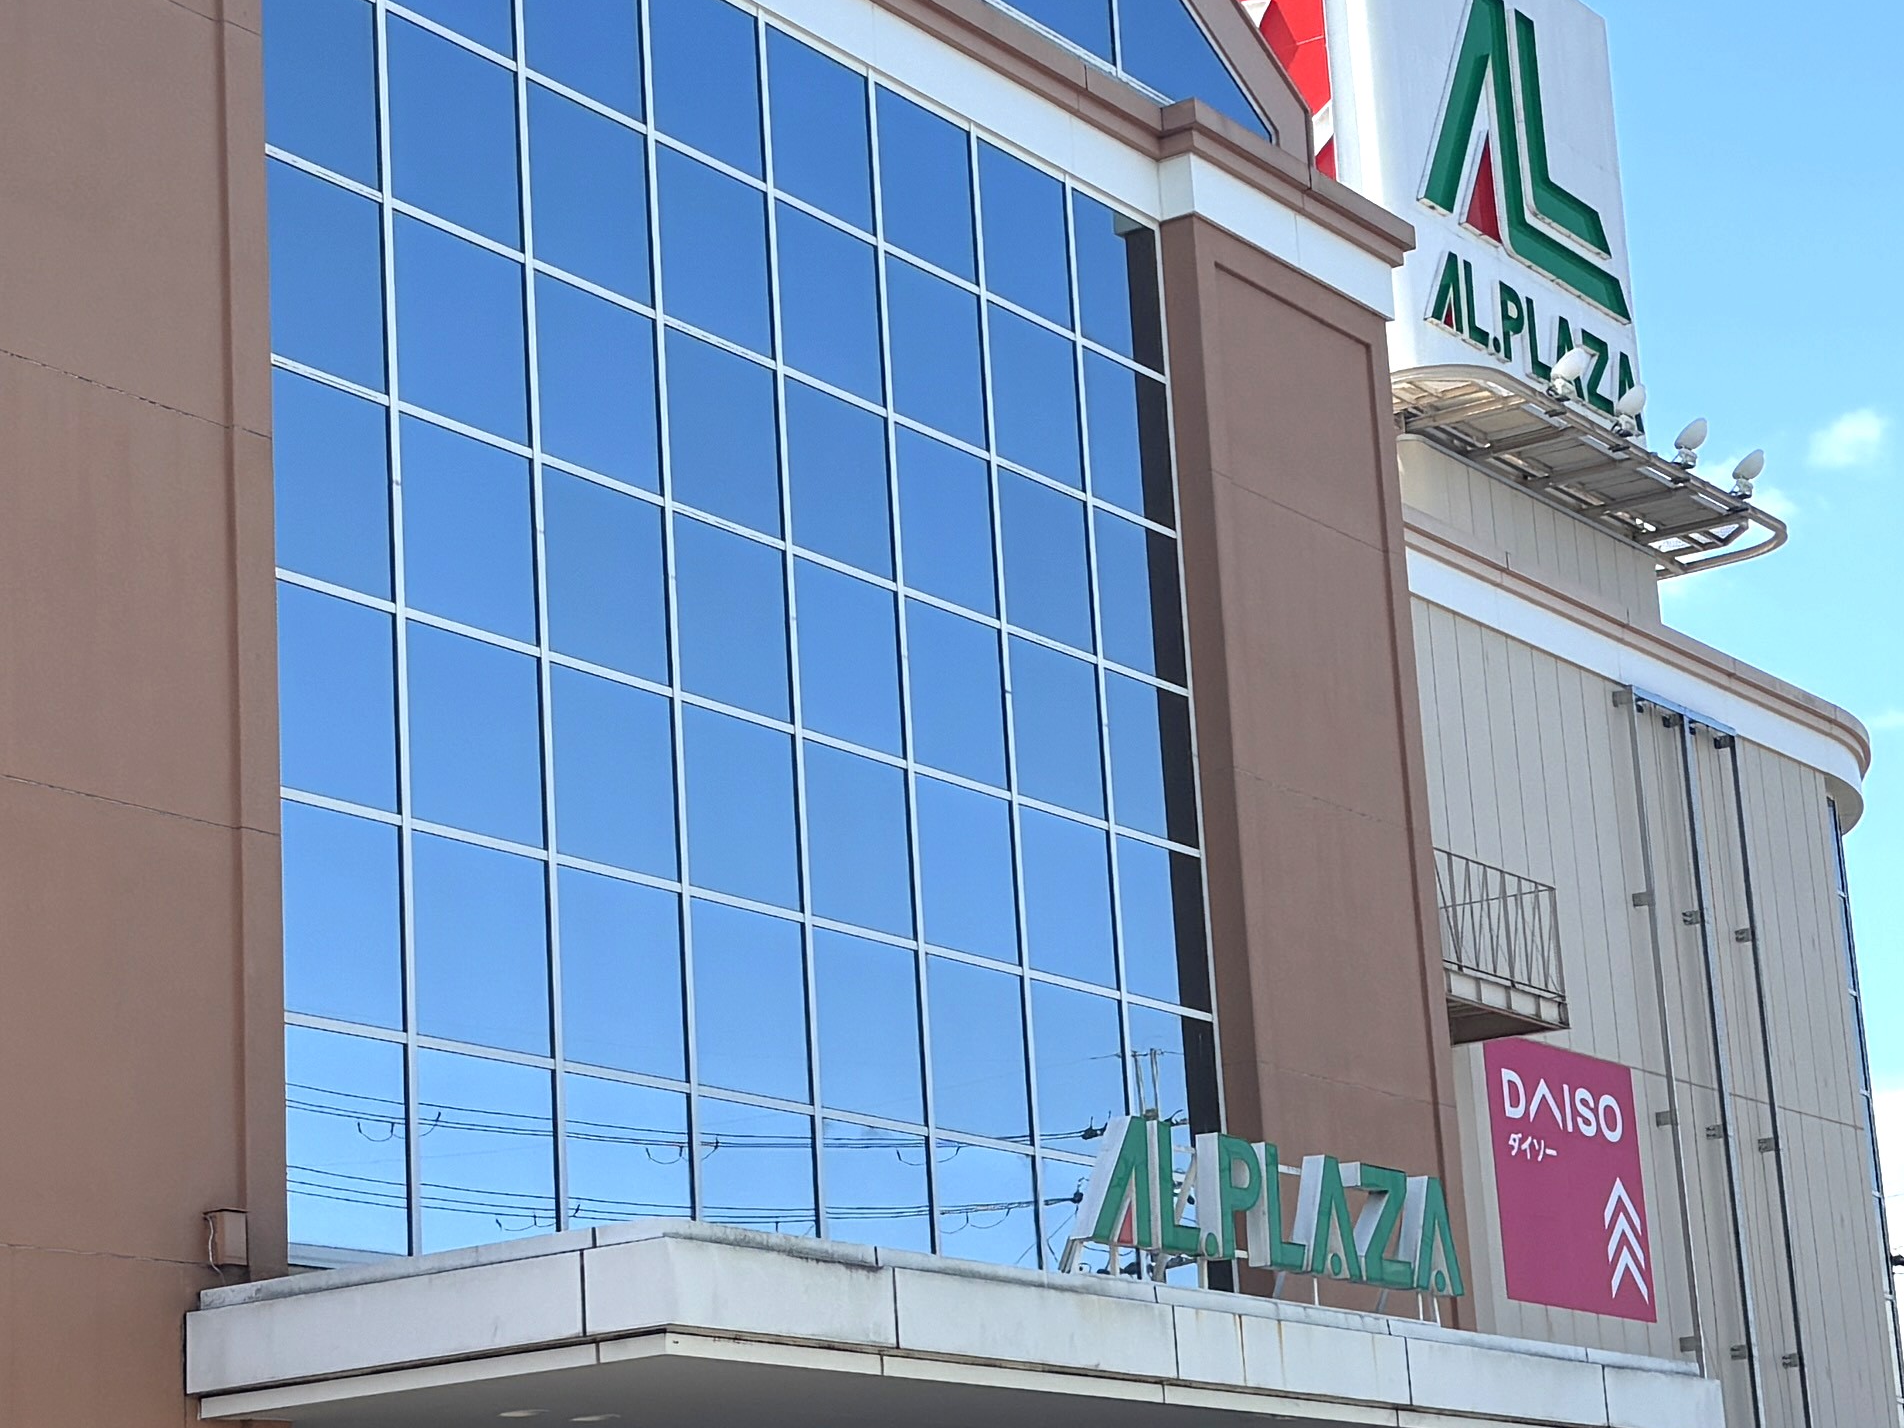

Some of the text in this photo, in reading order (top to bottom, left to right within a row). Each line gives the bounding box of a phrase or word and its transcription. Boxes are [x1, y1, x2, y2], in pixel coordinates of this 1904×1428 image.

[1500, 1066, 1624, 1143] DAISO
[1506, 1133, 1558, 1162] ダイソー
[1072, 1114, 1465, 1298] AL.PLAZA
